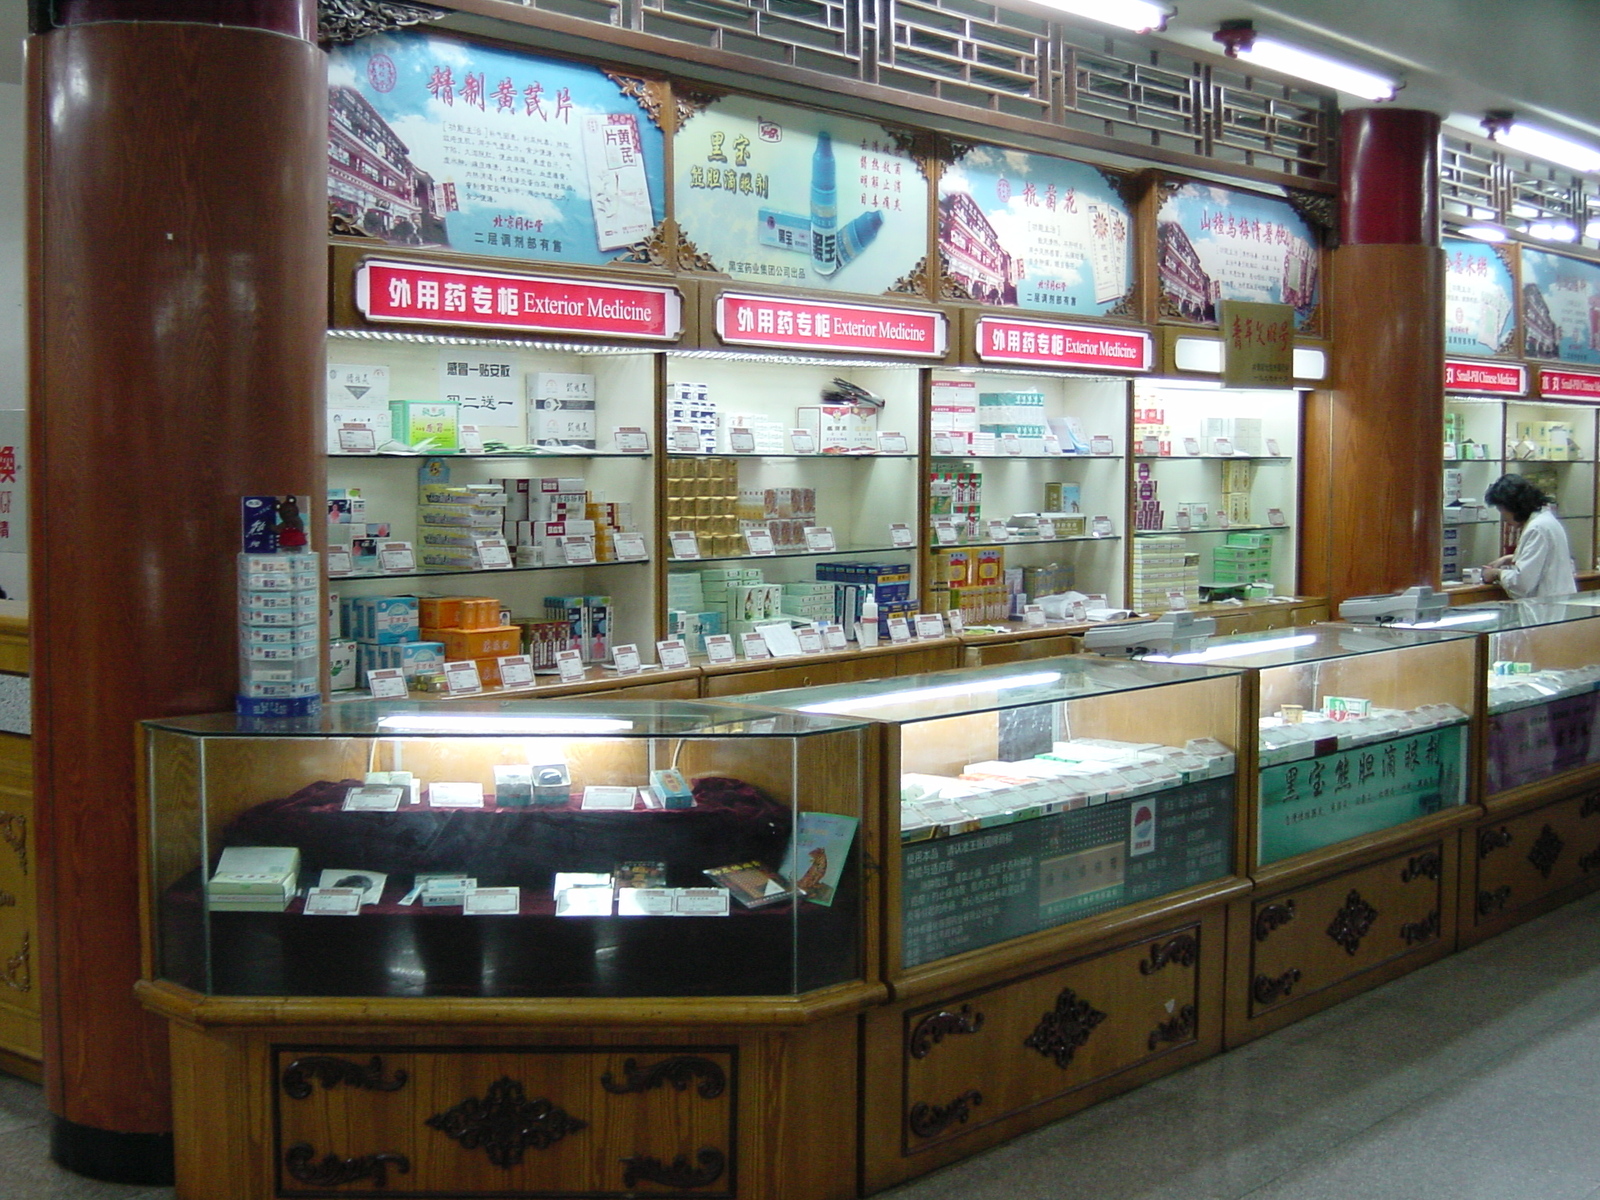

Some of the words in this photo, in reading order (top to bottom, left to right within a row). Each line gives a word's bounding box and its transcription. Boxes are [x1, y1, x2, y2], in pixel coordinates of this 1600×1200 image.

[474, 232, 562, 252] 二层调剂部有售
[728, 260, 806, 279] 黑宝药业集团公司出品
[388, 277, 519, 317] 外用药专柜
[523, 291, 584, 316] Exterior
[587, 297, 652, 322] Medicine
[737, 306, 831, 339] 外用药专柜
[833, 317, 879, 337] Exterior
[879, 322, 926, 342] Medicine
[992, 328, 1063, 356] 外用药专柜
[1065, 338, 1099, 356] Exterior
[1099, 341, 1137, 359] Medicine
[1497, 373, 1518, 386] Medicine
